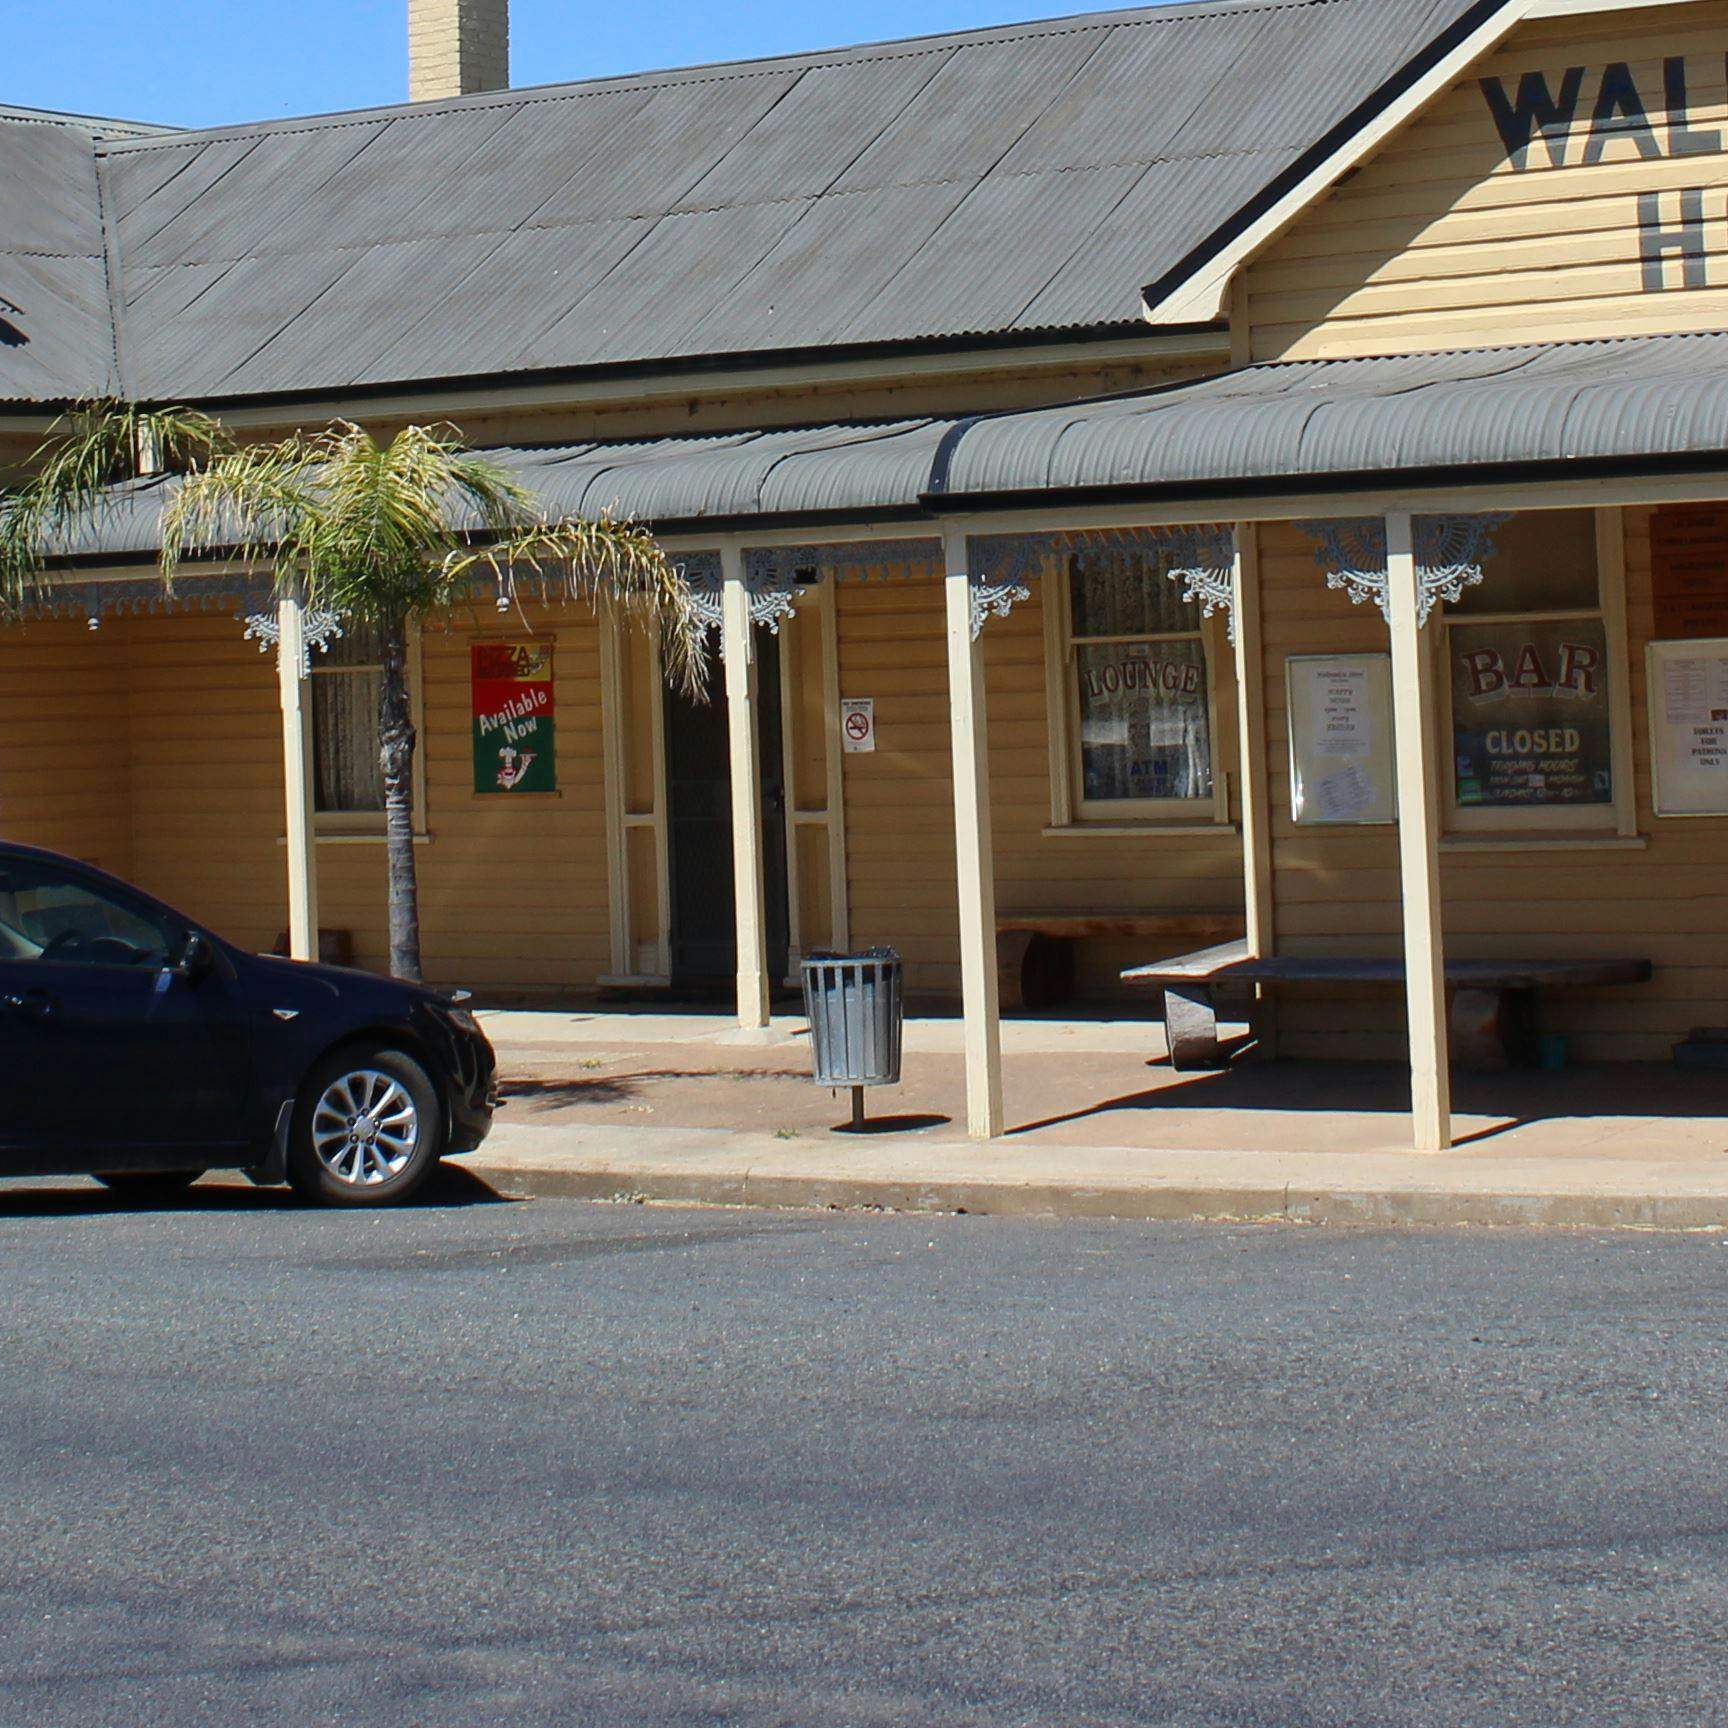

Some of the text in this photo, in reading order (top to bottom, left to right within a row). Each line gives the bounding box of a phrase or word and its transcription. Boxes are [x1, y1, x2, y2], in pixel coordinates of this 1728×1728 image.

[1084, 660, 1200, 702] LOUNGE
[1462, 642, 1599, 702] BAR
[479, 688, 547, 736] Available
[503, 715, 538, 744] Now
[1486, 728, 1581, 755] CLOSED
[1130, 759, 1169, 777] ATM
[1538, 758, 1580, 772] HOURS
